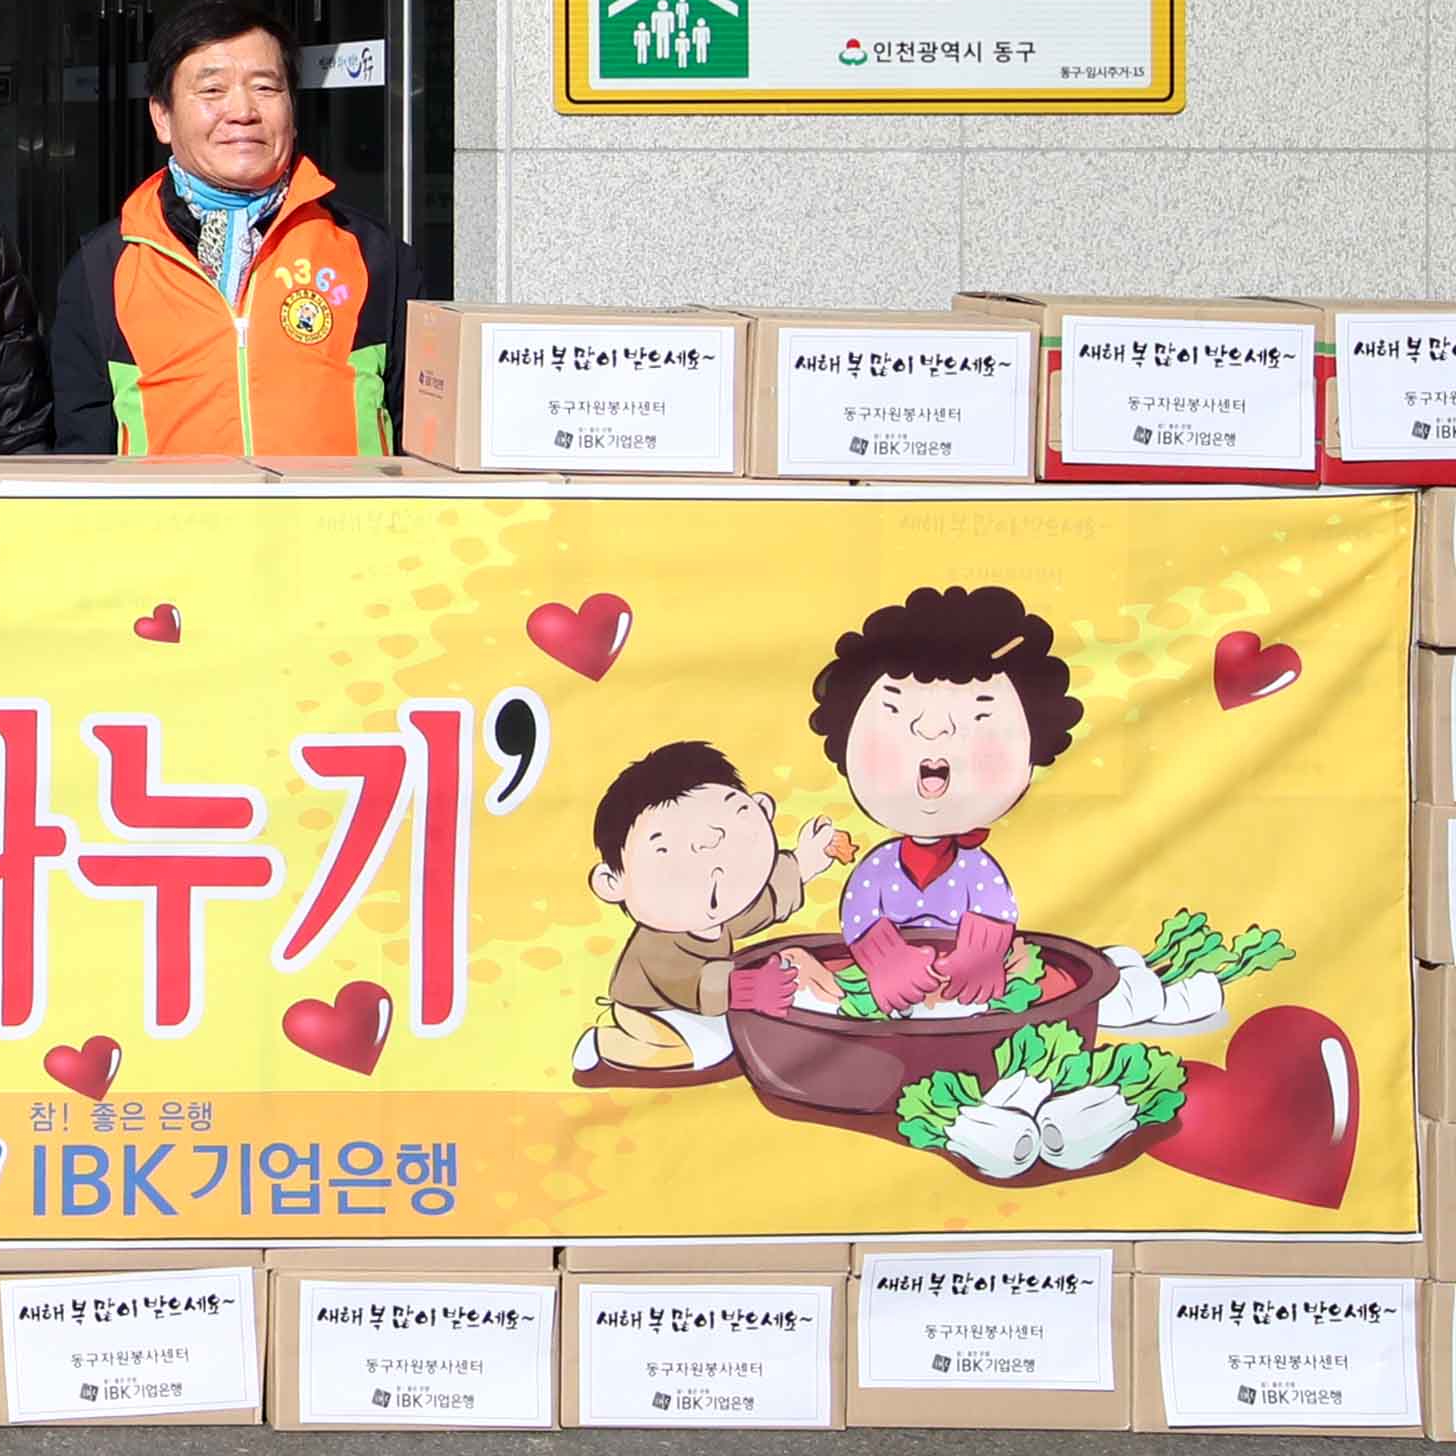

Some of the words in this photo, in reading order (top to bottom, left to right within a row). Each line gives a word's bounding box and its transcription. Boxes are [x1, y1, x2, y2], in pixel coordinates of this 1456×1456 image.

[872, 40, 985, 65] 인천광역시
[992, 40, 1037, 65] 동구
[274, 258, 349, 307] 1365
[499, 348, 544, 366] 새해
[552, 346, 566, 371] 복
[574, 347, 616, 370] 많이
[1080, 343, 1125, 362] 새해
[1132, 341, 1147, 367] 복
[1155, 343, 1197, 367] 많이
[1353, 339, 1400, 359] 새해
[1406, 336, 1422, 363] 복
[1429, 335, 1456, 362] 많
[795, 354, 840, 373] 새해
[848, 352, 862, 377] 복
[870, 353, 913, 376] 많이
[548, 400, 665, 416] 동구자원봉사센터
[844, 407, 961, 423] 동구자원봉사센터
[1127, 396, 1246, 414] 동구자원봉사센터
[28, 1101, 70, 1133] 참!
[90, 1101, 148, 1133] 좋은
[158, 1101, 215, 1133] 은행
[877, 1276, 923, 1293] 새해
[929, 1273, 945, 1296] 복
[952, 1272, 995, 1295] 많이
[19, 1304, 64, 1321] 새해
[72, 1300, 86, 1324] 복
[94, 1298, 137, 1322] 많이
[317, 1307, 362, 1325] 새해
[370, 1304, 385, 1330] 복
[393, 1305, 435, 1328] 많이
[597, 1310, 641, 1328] 새해
[649, 1307, 664, 1333] 복
[672, 1308, 714, 1332] 많이
[1177, 1304, 1223, 1321] 새해
[1230, 1300, 1246, 1326] 복
[1253, 1301, 1296, 1324] 많이
[925, 1324, 1044, 1340] 동구자원봉사센터
[71, 1348, 189, 1369] 동구자원봉사센터
[366, 1359, 483, 1375] 동구자원봉사센터
[646, 1362, 763, 1378] 동구자원봉사센터
[1228, 1354, 1348, 1371] 동구자원봉사센터
